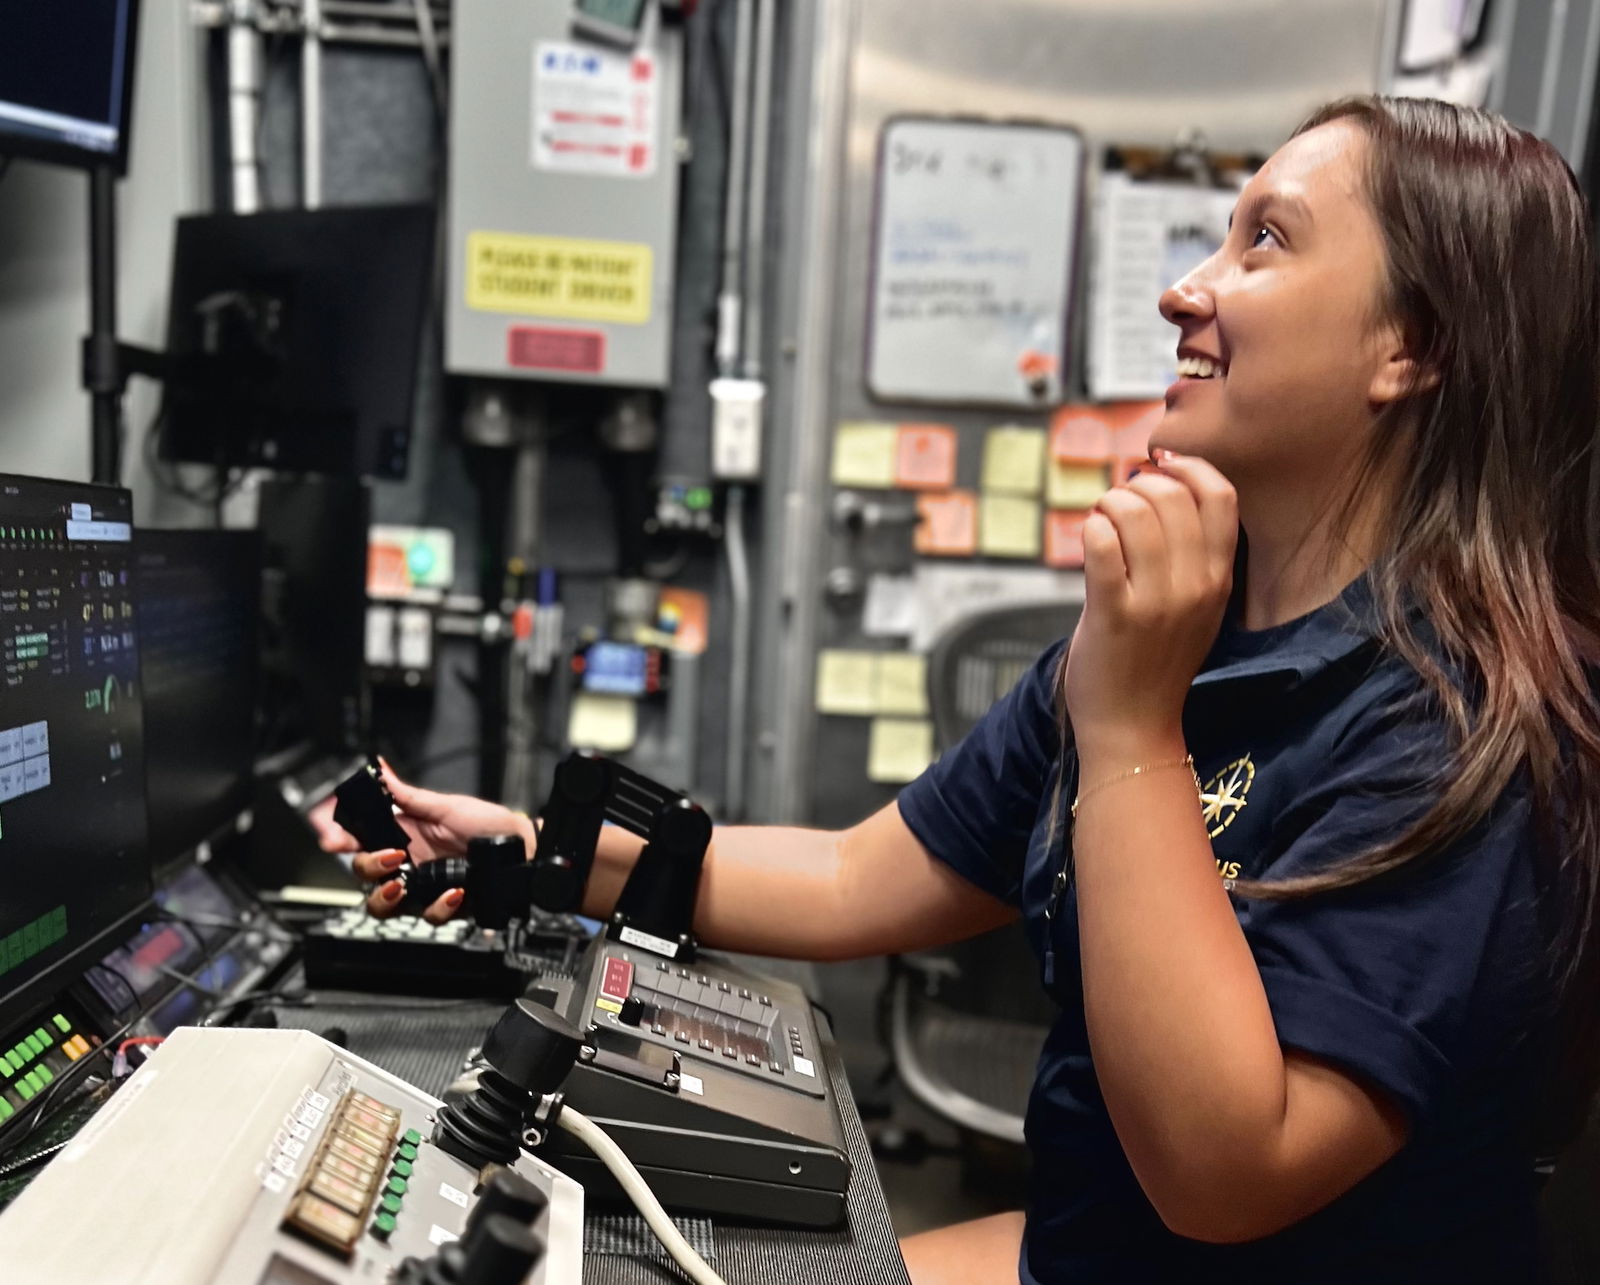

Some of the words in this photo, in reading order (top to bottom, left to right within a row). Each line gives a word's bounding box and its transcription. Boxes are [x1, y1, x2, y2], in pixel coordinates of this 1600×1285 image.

[480, 246, 540, 270] PLEASE
[545, 253, 561, 272] BE
[568, 255, 637, 276] PATIENT
[478, 273, 558, 297] STUDENT
[569, 281, 635, 304] DRIVER
